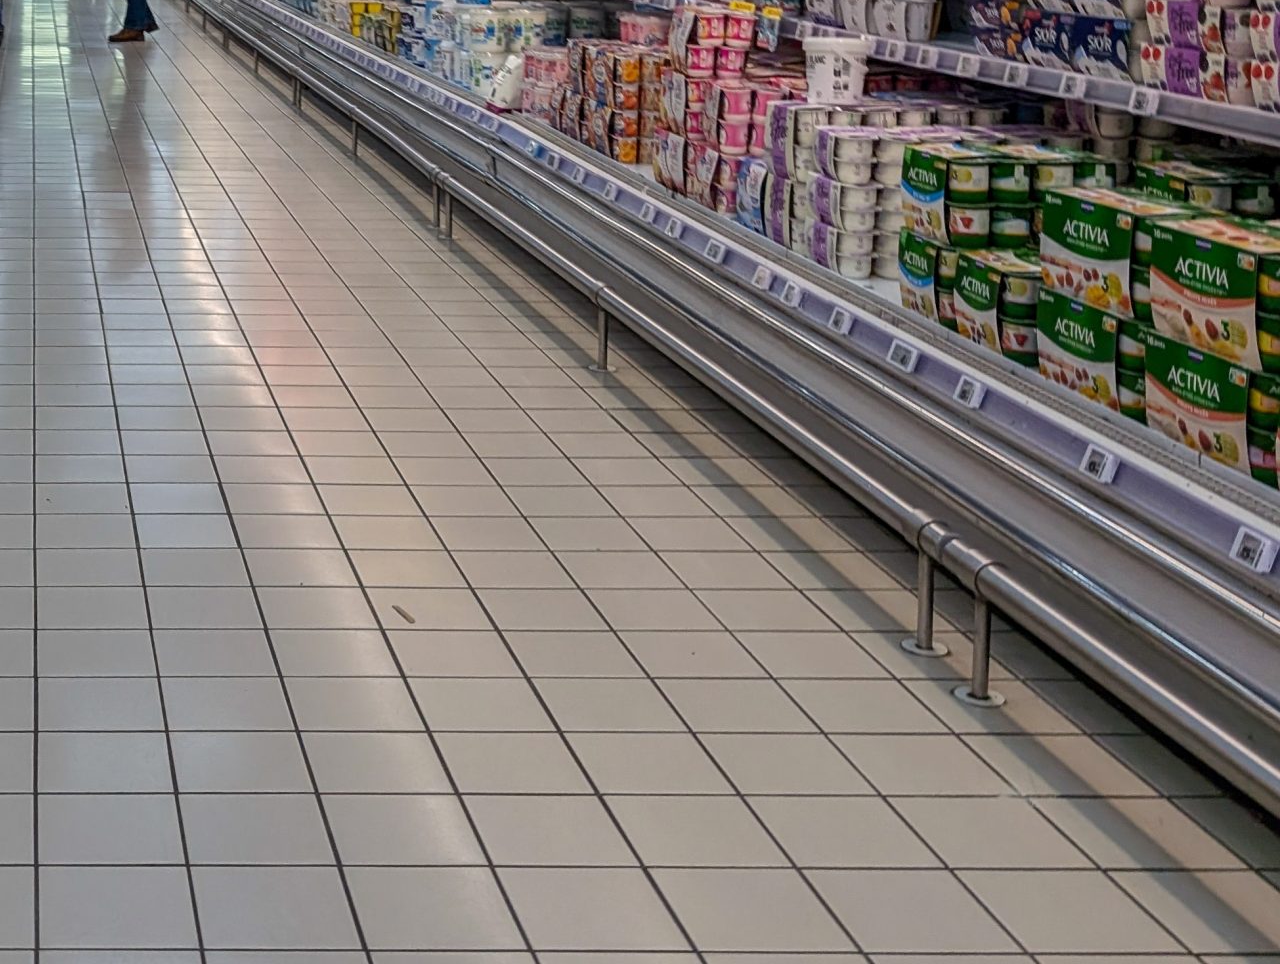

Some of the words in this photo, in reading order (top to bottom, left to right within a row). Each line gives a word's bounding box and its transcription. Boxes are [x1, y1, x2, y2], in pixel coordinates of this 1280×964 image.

[1034, 27, 1056, 45] SKYR
[1087, 35, 1112, 53] SKYR
[908, 166, 938, 187] ACTIVIA
[1062, 217, 1110, 247] ACTIVIA
[903, 250, 929, 273] ACTIVIA
[1174, 255, 1229, 290] ACTIVIA
[960, 275, 990, 301] ACTIVIA
[1054, 316, 1095, 348] ACTIVIA
[1167, 365, 1220, 403] ACTIVIA
